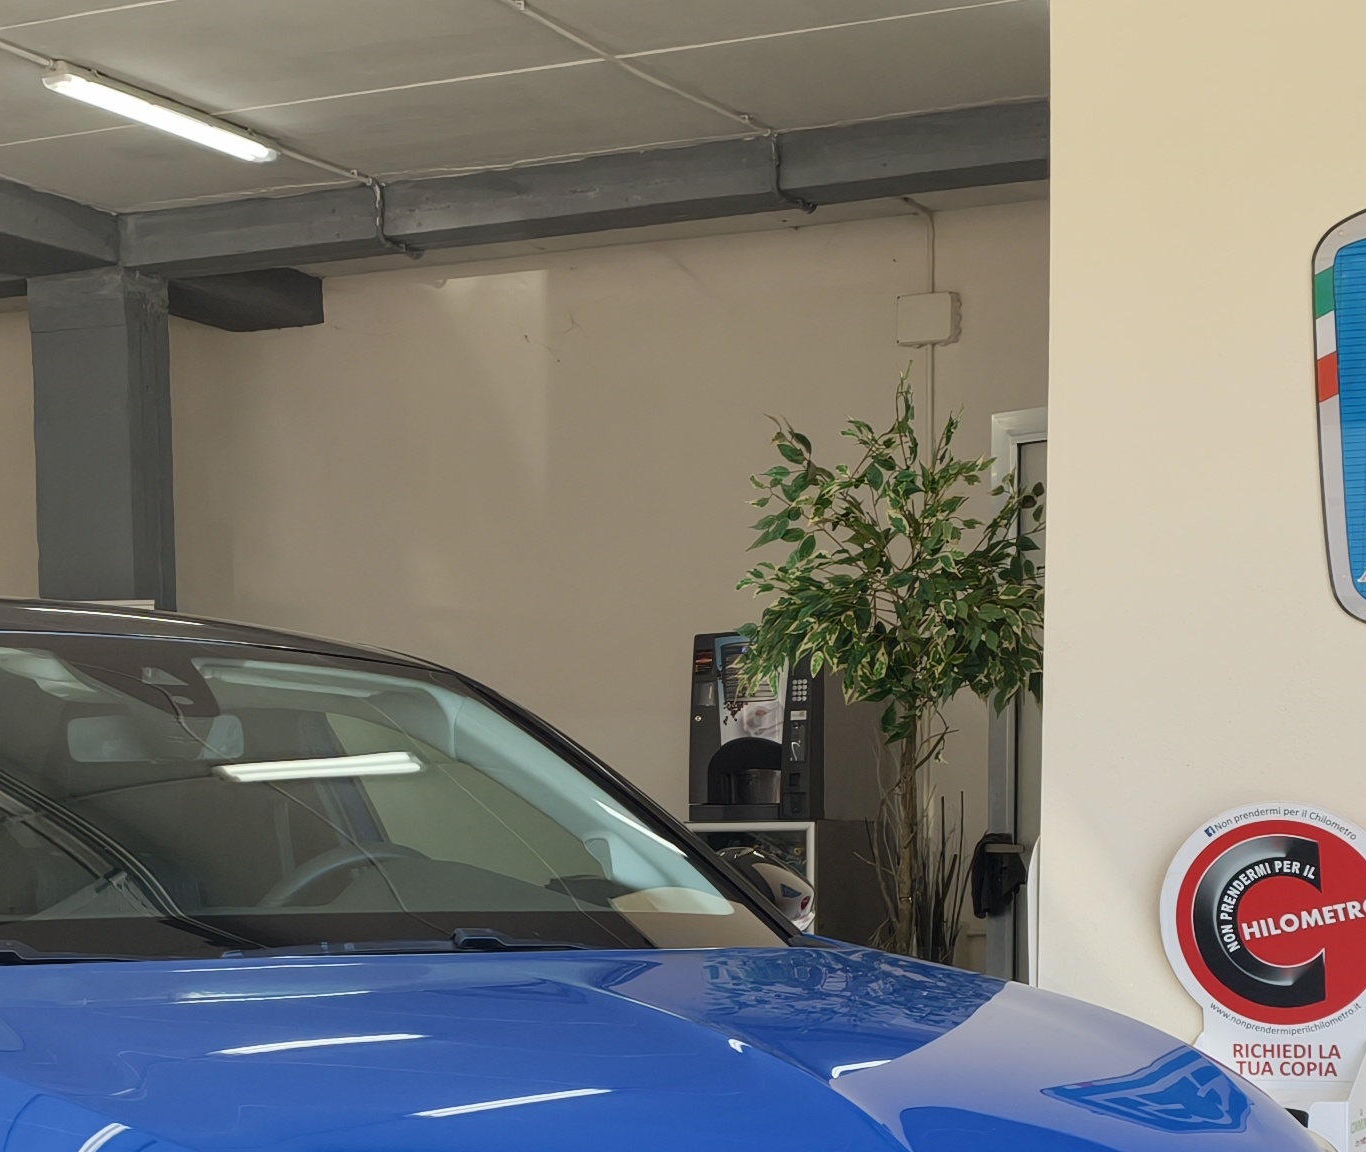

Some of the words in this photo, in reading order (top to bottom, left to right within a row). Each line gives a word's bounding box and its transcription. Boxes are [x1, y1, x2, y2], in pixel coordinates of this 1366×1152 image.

[1214, 818, 1233, 832] Non
[1233, 806, 1281, 824] prendermi
[1283, 808, 1299, 817] per
[1301, 809, 1308, 818] il
[1309, 811, 1357, 841] Chilometro
[1274, 860, 1300, 875] PER
[1302, 864, 1316, 880] IL
[1220, 862, 1272, 920] PRENDERMI
[1220, 924, 1241, 953] NON
[1210, 1002, 1362, 1037] www.nonprendermiperilchilometro.it
[1232, 1043, 1312, 1059] RICHIEDI
[1318, 1044, 1342, 1060] LA
[1236, 1060, 1274, 1076] TUA
[1280, 1061, 1338, 1077] COPIA
